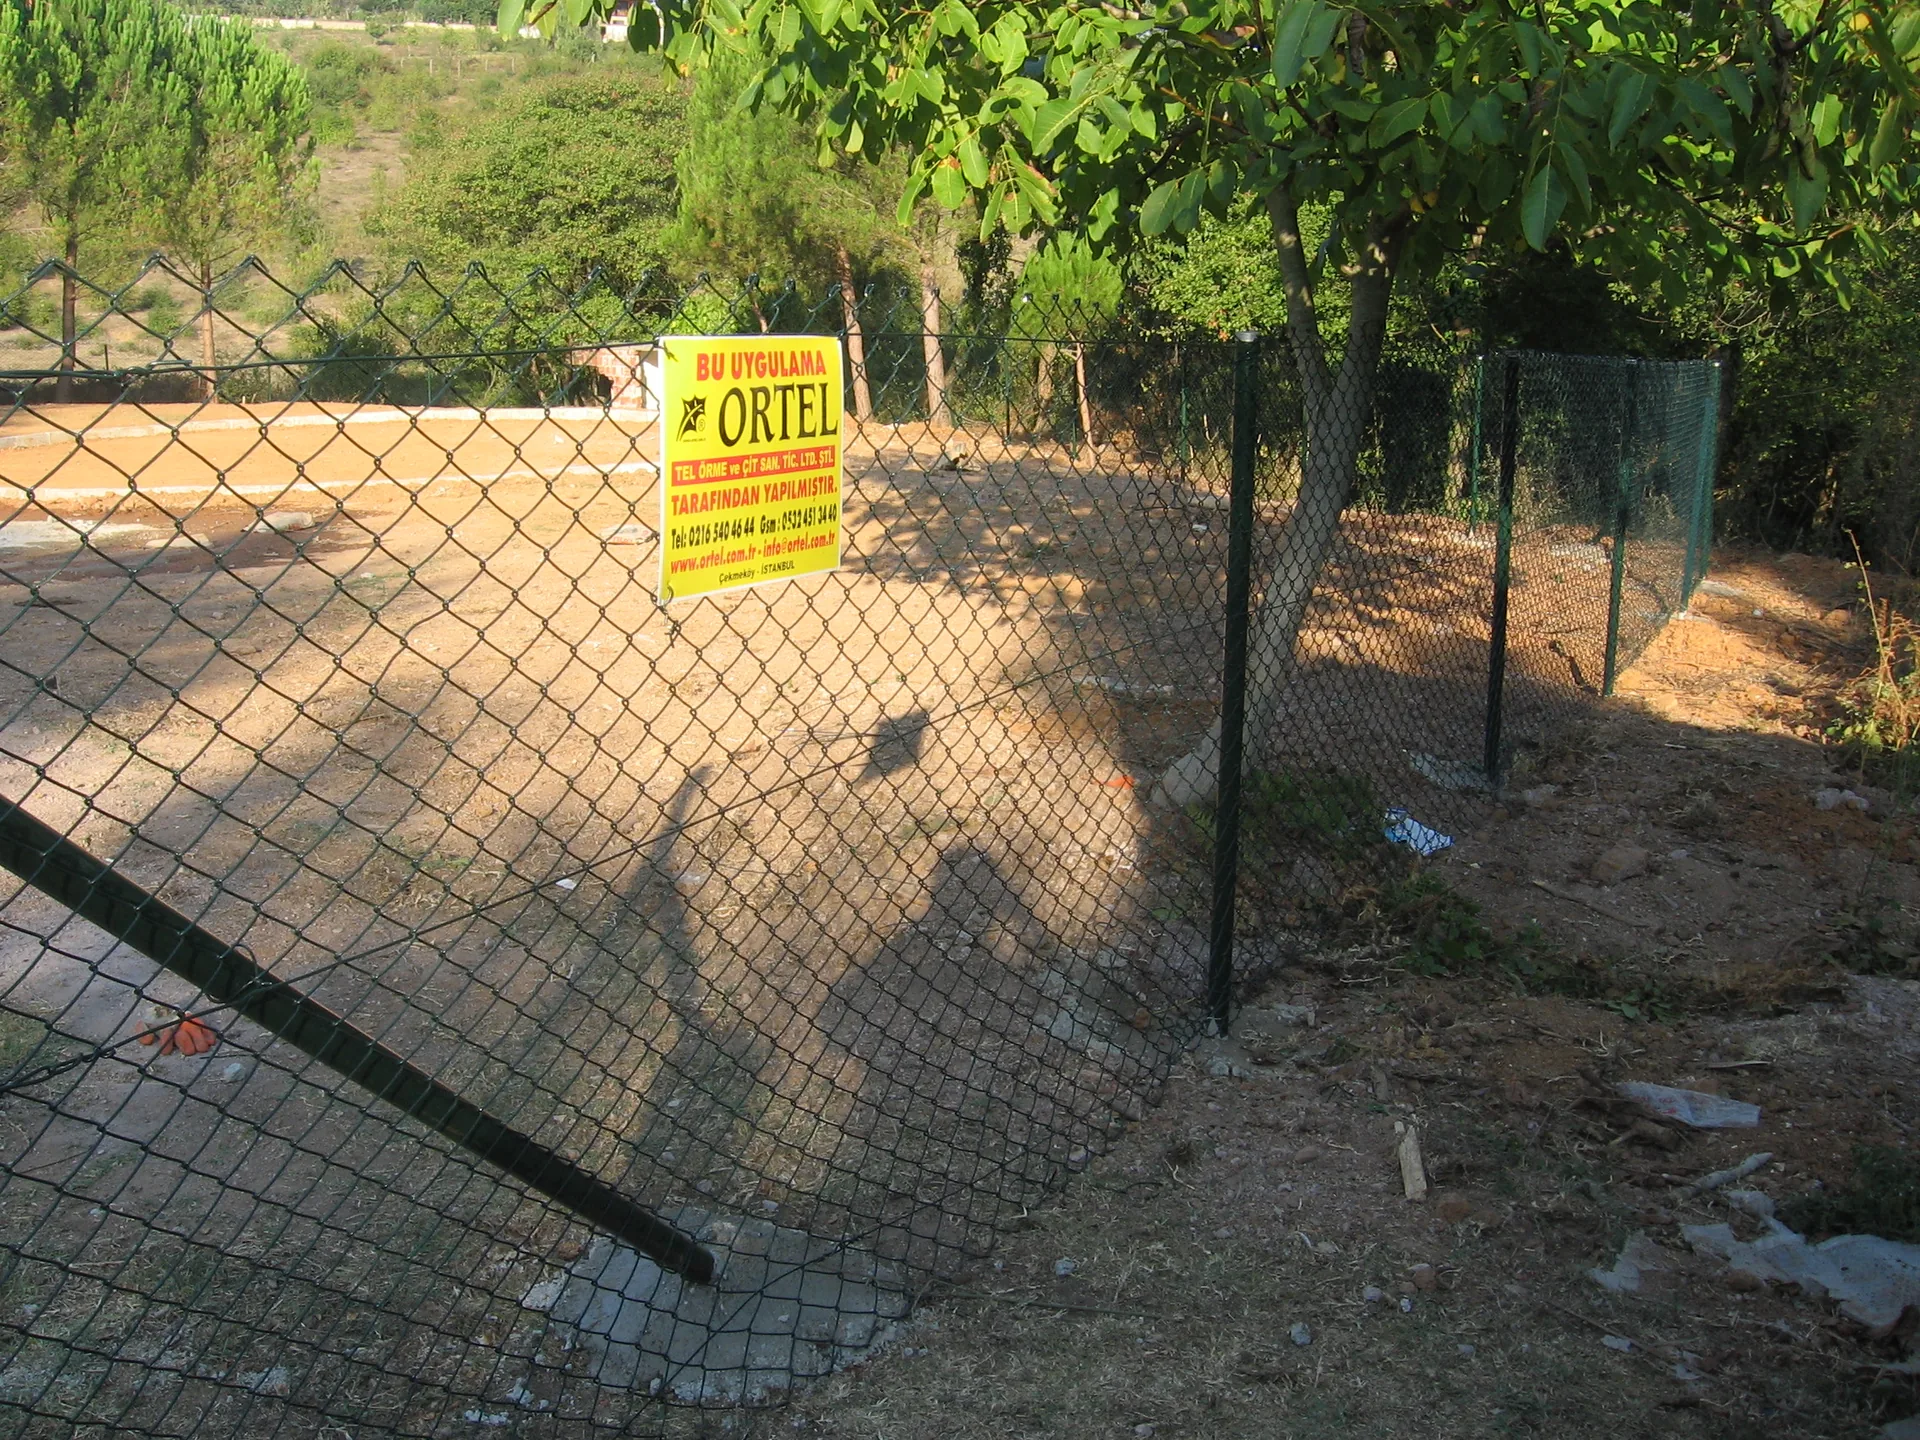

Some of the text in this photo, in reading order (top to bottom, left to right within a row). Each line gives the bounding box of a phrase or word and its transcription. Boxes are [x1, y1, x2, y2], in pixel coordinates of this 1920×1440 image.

[697, 351, 826, 381] BU UYGULAMA
[719, 382, 838, 447] ORTEL
[676, 465, 695, 480] TEL
[699, 462, 726, 478] ÖRME
[730, 465, 740, 474] ve
[743, 455, 759, 477] ÇİT
[760, 458, 780, 472] SAN.
[783, 453, 798, 469] TİC.
[801, 453, 817, 467] LTD.
[672, 475, 837, 515] TARAFINDAN YAPILMIŞTIR.
[672, 526, 686, 549] Tel:
[689, 524, 710, 547] 0216
[713, 520, 729, 542] 540
[732, 519, 742, 537] 46
[744, 516, 754, 536] 44
[782, 508, 802, 531] 0532
[803, 506, 816, 527] 451
[818, 505, 827, 523] 34
[828, 503, 836, 522] 40
[671, 544, 755, 574] www.ortel.com.tr
[764, 531, 835, 557] info@ortel.com.tr
[719, 567, 754, 584] Çekmeköy
[761, 561, 795, 574] İSTANBUL
